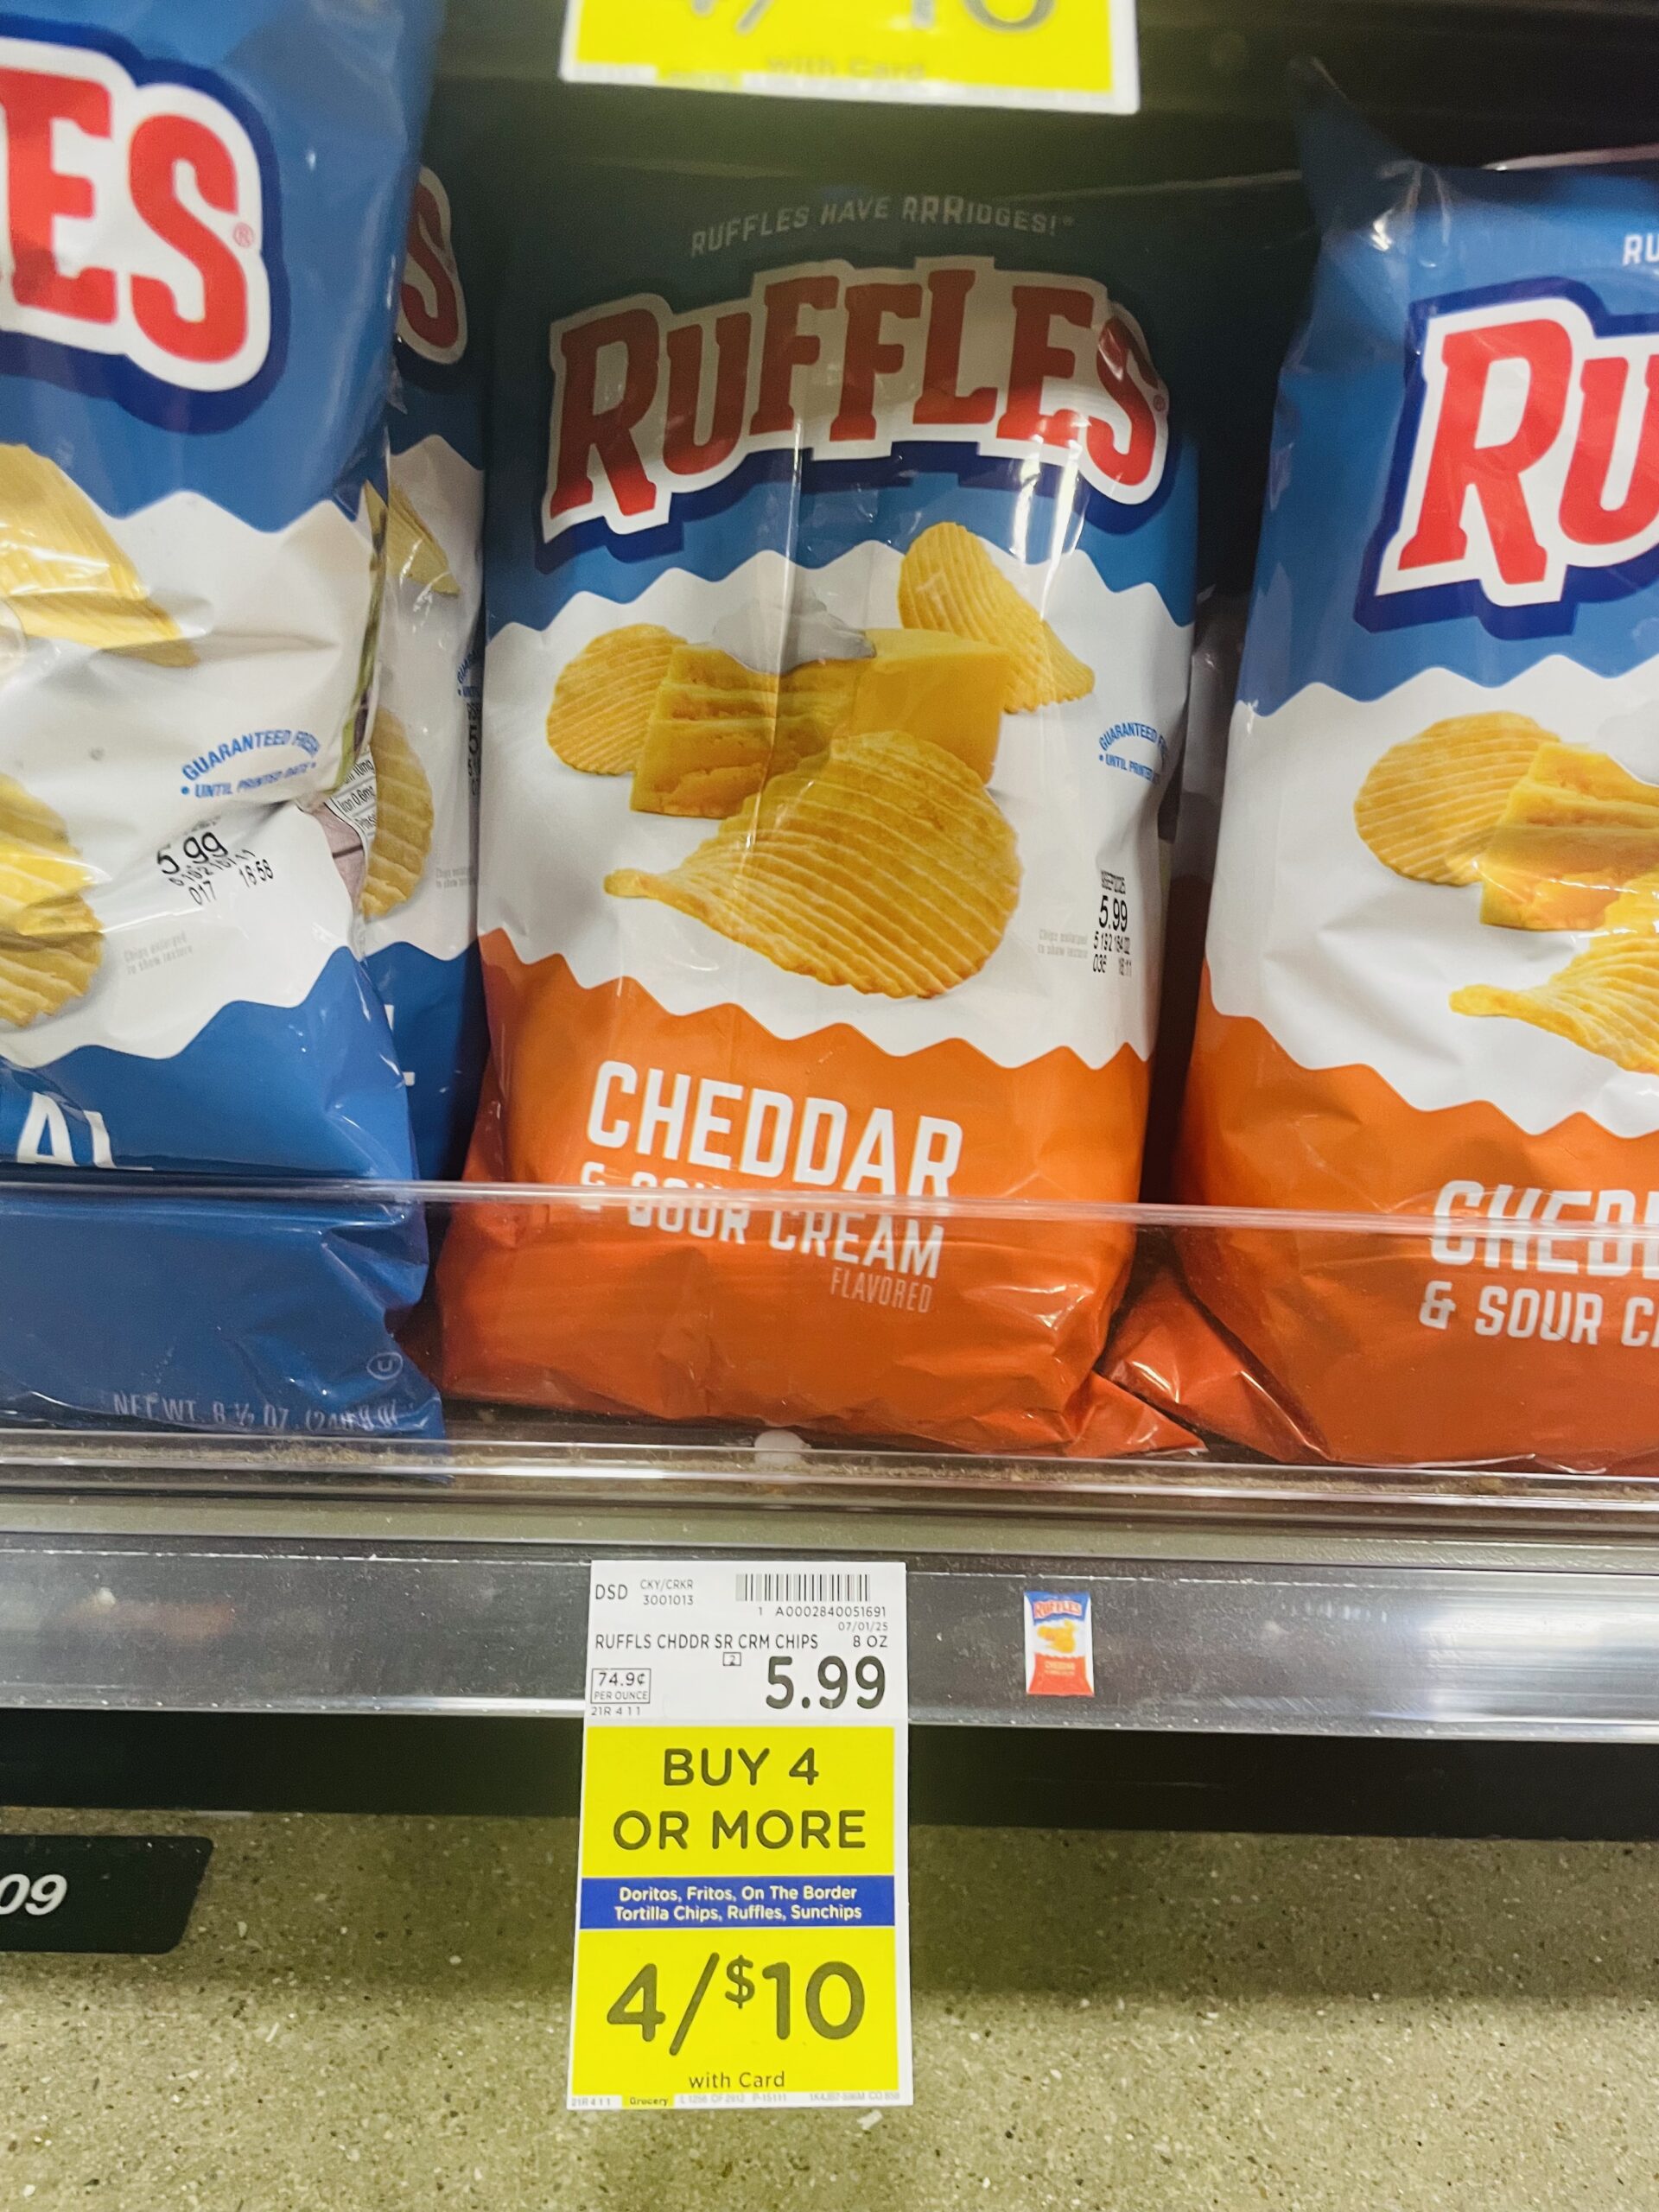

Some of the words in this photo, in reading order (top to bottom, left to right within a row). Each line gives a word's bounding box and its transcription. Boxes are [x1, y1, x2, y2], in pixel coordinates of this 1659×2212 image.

[691, 206, 810, 257] RUFFLES
[819, 194, 891, 226] HAVE
[548, 264, 1164, 524] RUFFLES
[1396, 317, 1659, 586] RU
[181, 729, 292, 781] GUARANTEED
[1099, 721, 1158, 752] GUARANTEED
[1098, 894, 1128, 932] 5.99
[588, 1060, 963, 1201] CHEDDAR
[768, 1205, 944, 1279] CREAM
[830, 1267, 933, 1313] FLAVORED
[1419, 1280, 1456, 1330] &
[1474, 1286, 1604, 1345] SOUR
[595, 1584, 628, 1600] DSD
[639, 1579, 694, 1592] CKY/CRKR
[643, 1595, 694, 1606] 3001013
[775, 1606, 887, 1618] A0002840051691
[837, 1621, 889, 1632] 07/01/25
[594, 1634, 652, 1649] RUFFLS
[657, 1634, 710, 1649] CHDDR
[715, 1634, 734, 1649] SR
[738, 1634, 770, 1649] CRM
[775, 1634, 819, 1649] CHIPS
[852, 1635, 861, 1649] 8
[866, 1635, 889, 1649] OZ
[594, 1690, 613, 1700] PER
[614, 1690, 649, 1700] OUNCE
[598, 1672, 646, 1687] 74.9¢
[766, 1655, 887, 1710] 5.99
[663, 1747, 771, 1787] BUY
[788, 1747, 820, 1786] 4
[613, 1809, 690, 1851] OR
[711, 1808, 867, 1850] MORE
[619, 1886, 683, 1903] Doritos,
[687, 1885, 737, 1902] Fritos,
[741, 1885, 765, 1900] On
[770, 1885, 798, 1900] The
[803, 1885, 857, 1900] Border
[614, 1905, 670, 1921] Tortilla
[673, 1904, 723, 1923] Chips,
[727, 1904, 786, 1922] Ruffles,
[791, 1904, 862, 1921] Sunchips
[607, 1951, 866, 2056] 4/$10
[689, 2071, 731, 2089] with
[739, 2070, 785, 2088] Card
[629, 2096, 669, 2107] Grocery
